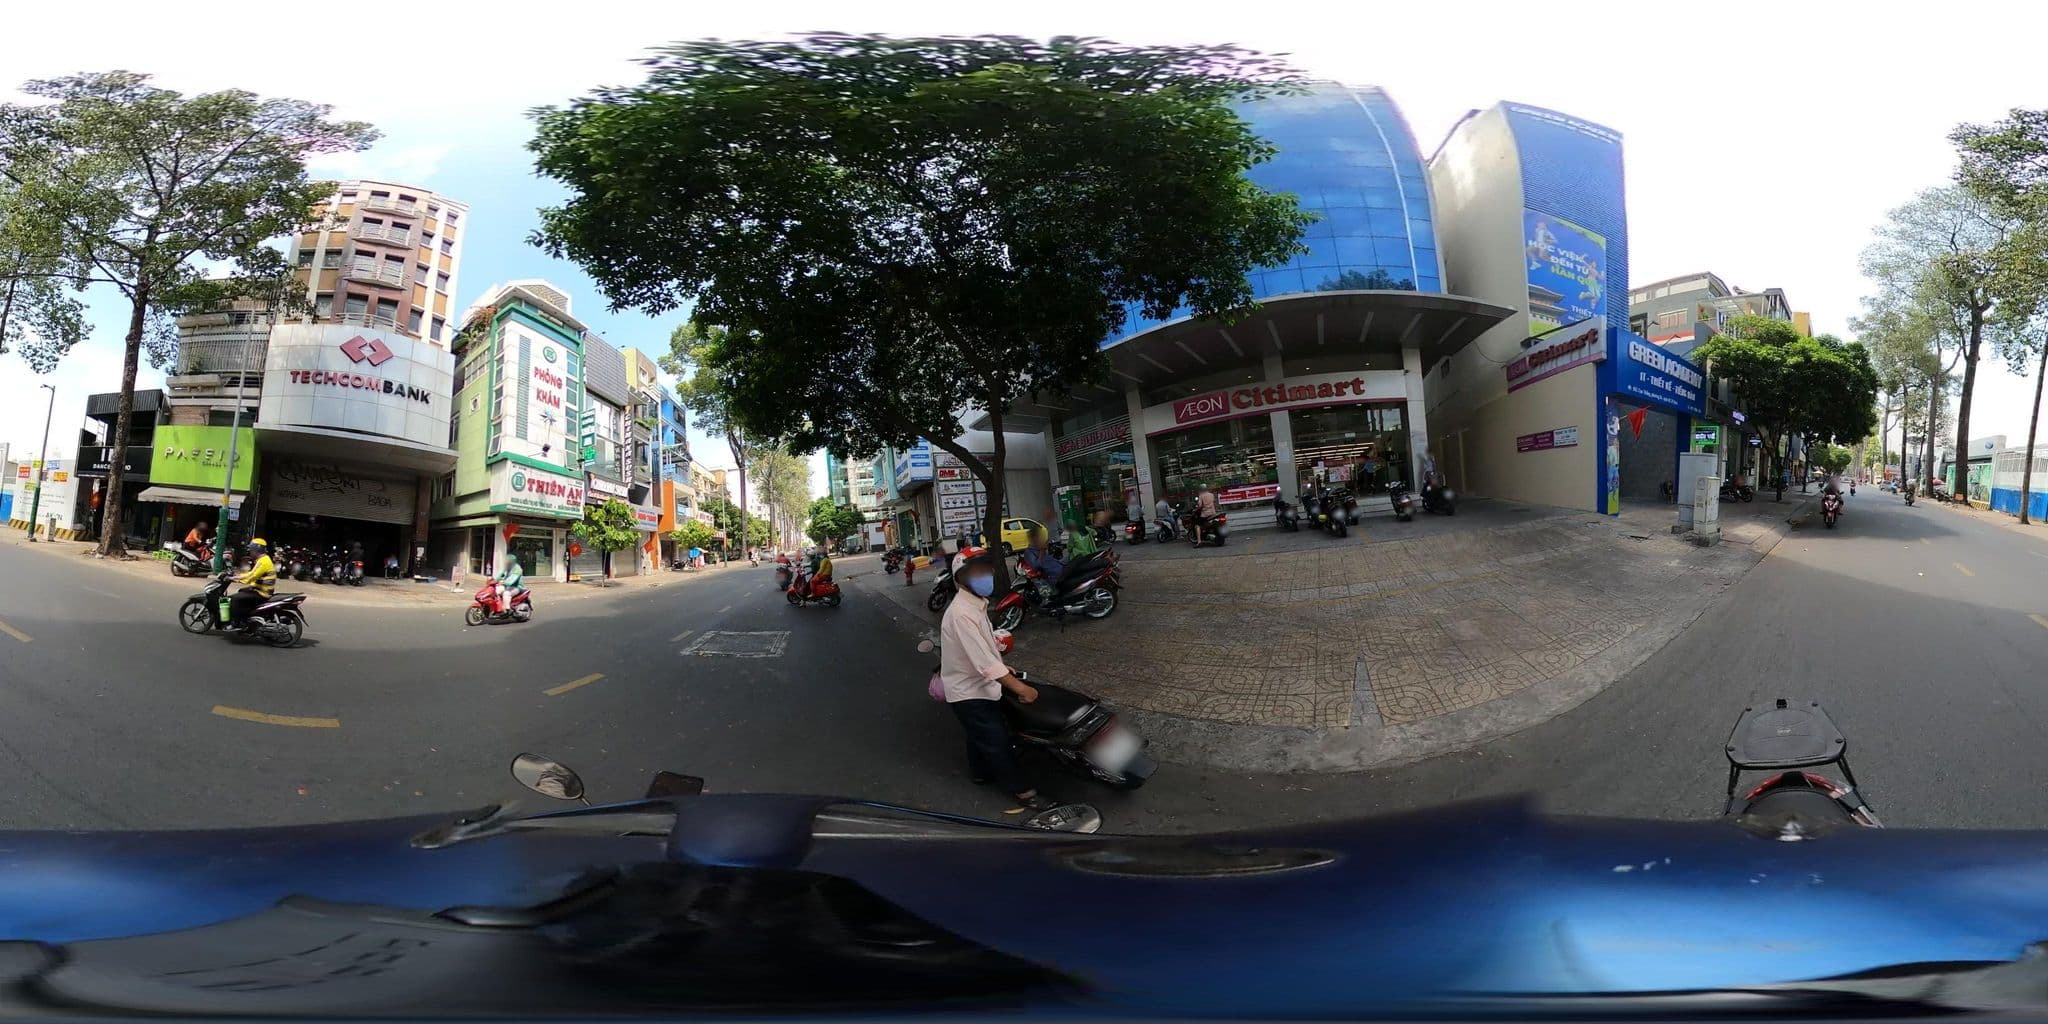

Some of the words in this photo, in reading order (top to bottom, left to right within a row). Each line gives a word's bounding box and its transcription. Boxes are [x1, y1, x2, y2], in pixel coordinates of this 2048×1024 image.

[534, 367, 563, 389] PHÒNG
[1629, 341, 1666, 372] GREEN
[1665, 358, 1702, 389] ACADEMY
[290, 370, 432, 405] TECHCOMBANK
[536, 387, 560, 409] KHÁM
[1231, 377, 1366, 409] Citimart
[1077, 423, 1128, 449] BUILDING
[164, 446, 241, 463] PASSIO
[625, 459, 633, 488] SUSHI
[527, 478, 566, 498] THIÊN
[566, 487, 583, 500] AN
